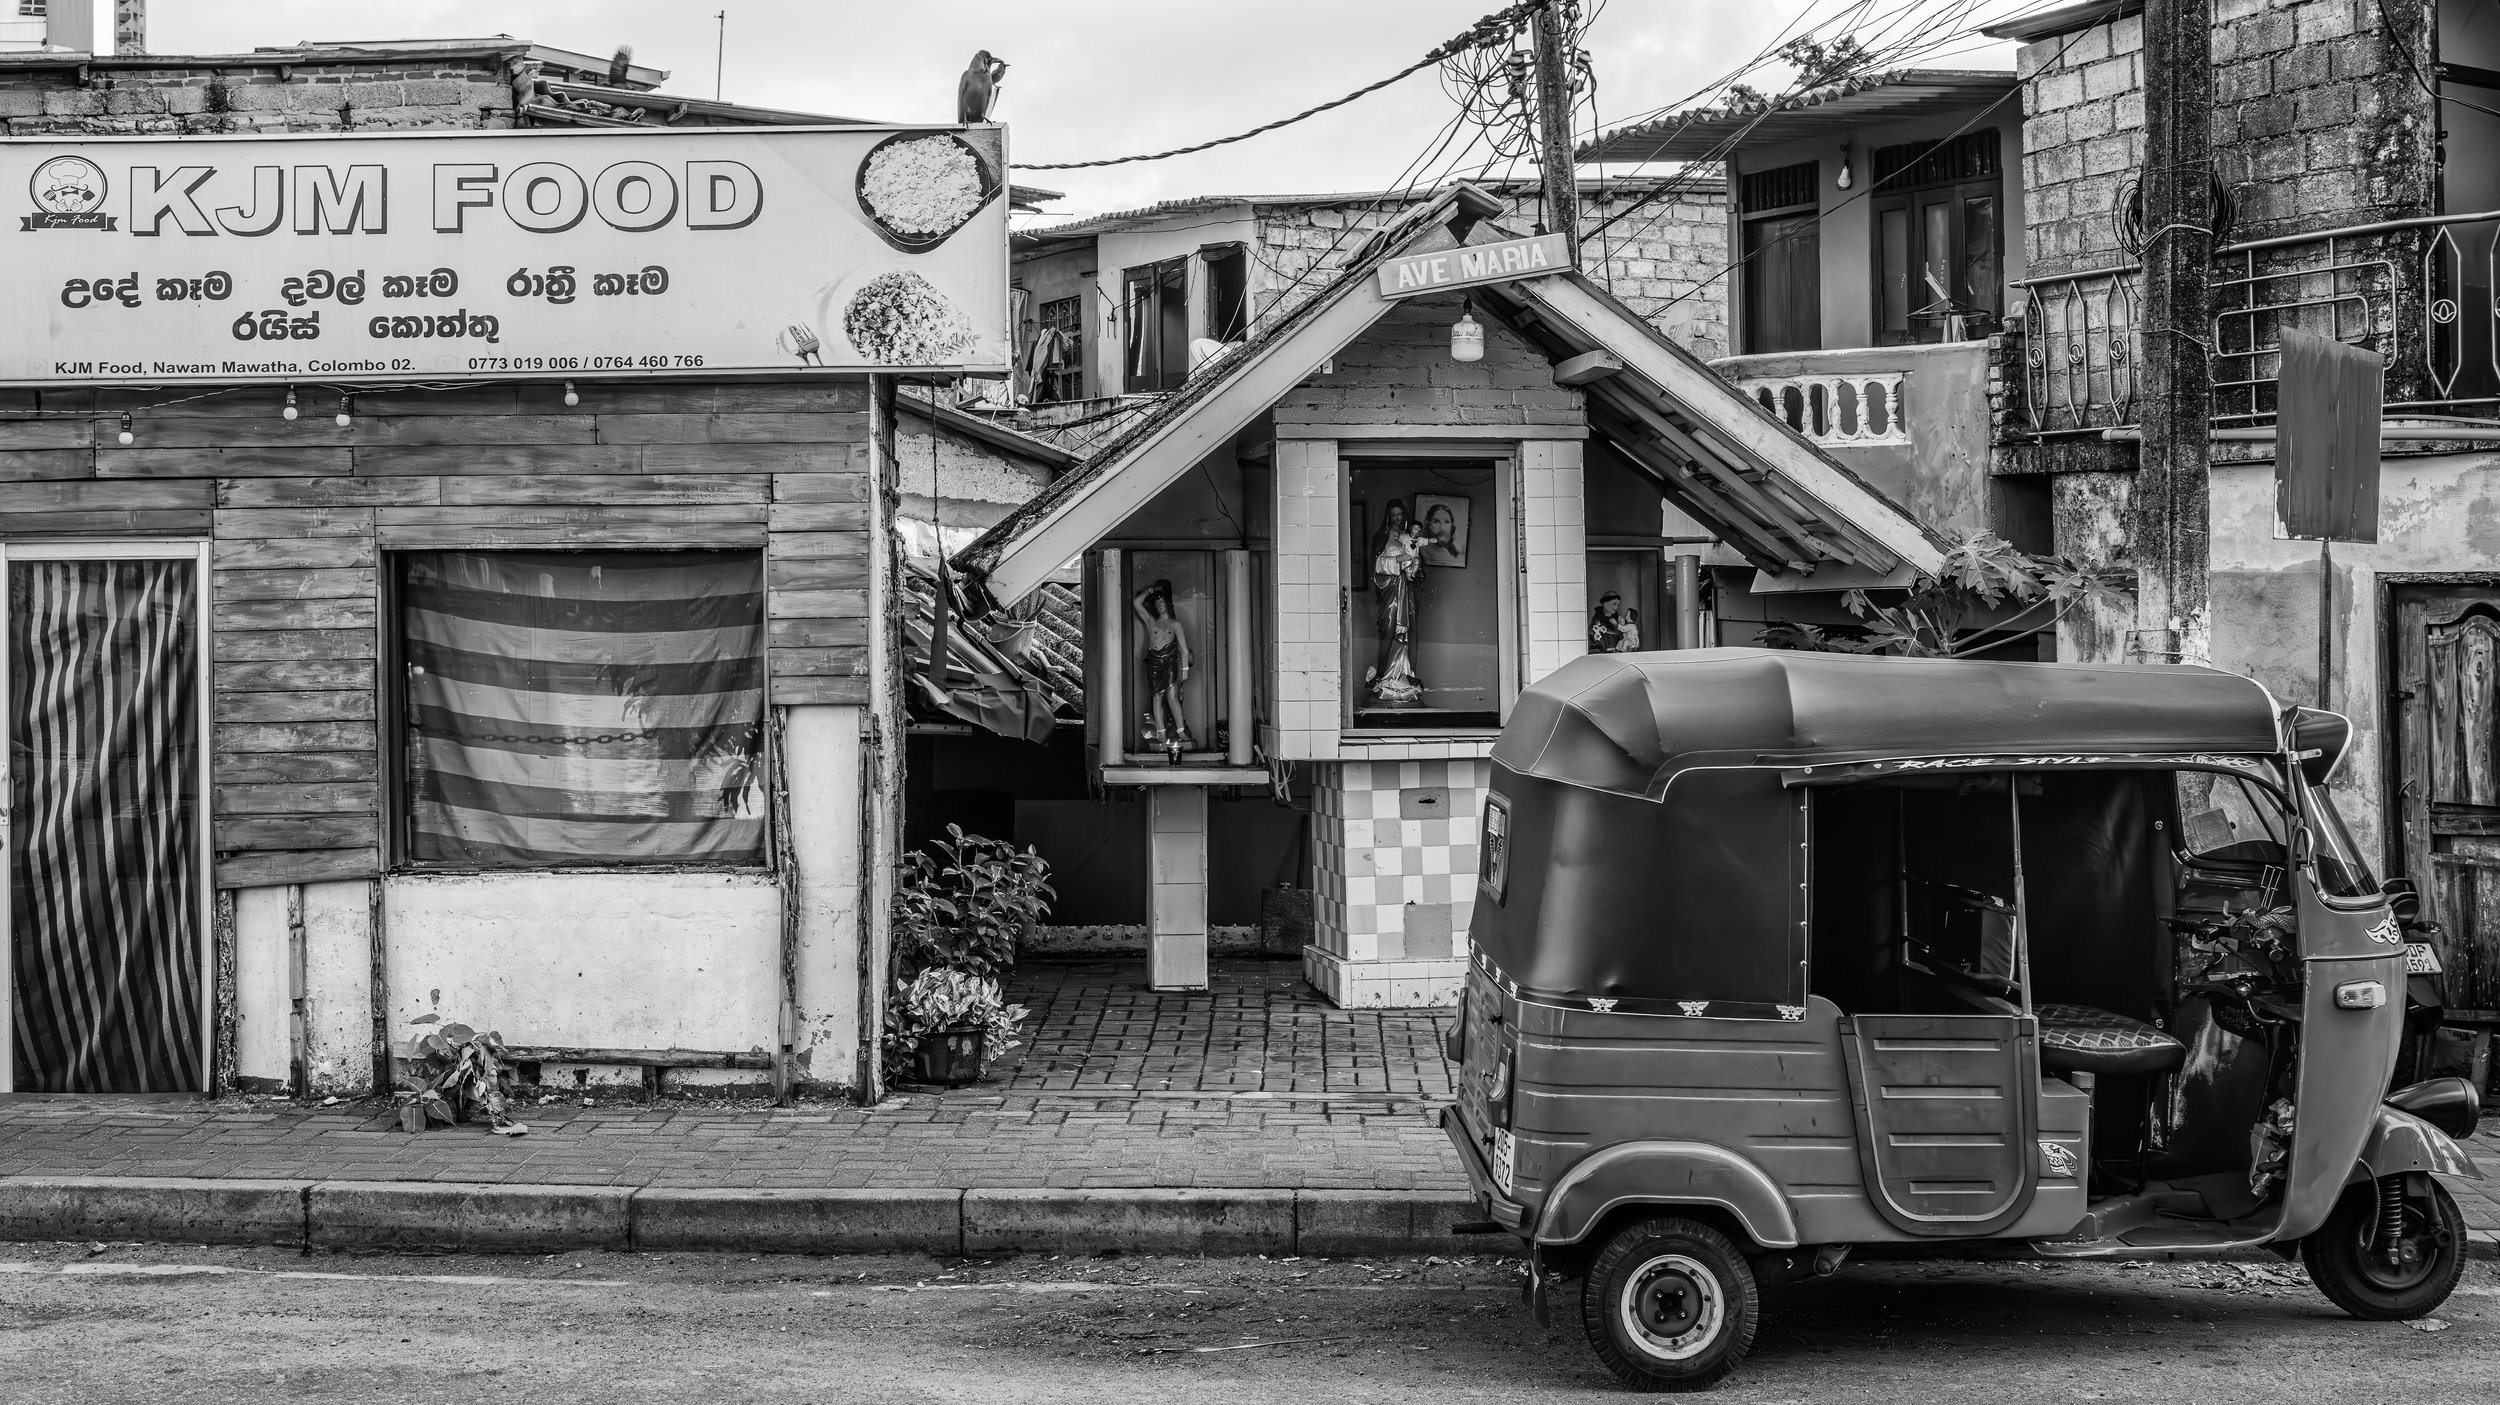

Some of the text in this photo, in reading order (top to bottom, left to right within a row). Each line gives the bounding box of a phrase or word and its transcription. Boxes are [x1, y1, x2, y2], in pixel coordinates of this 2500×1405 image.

[129, 160, 764, 237] KJM FOOD
[44, 213, 99, 229] Kjm Food
[1399, 243, 1548, 289] AVE MARIA
[61, 272, 142, 309] උදේ
[156, 270, 233, 301] කෑම
[280, 269, 366, 306] දවල්
[382, 267, 459, 298] කෑම
[593, 265, 669, 296] කෑම
[232, 308, 500, 343] රයිස් කොත්තු
[55, 358, 416, 376] KJM Food, Nawam Mawatha, Colombo 02.
[468, 357, 508, 371] 0773
[513, 357, 543, 371] 019
[548, 356, 578, 370] 006
[593, 356, 634, 370] 0764
[639, 355, 669, 369] 460
[673, 354, 704, 368] 766
[1895, 757, 1995, 770] RACE
